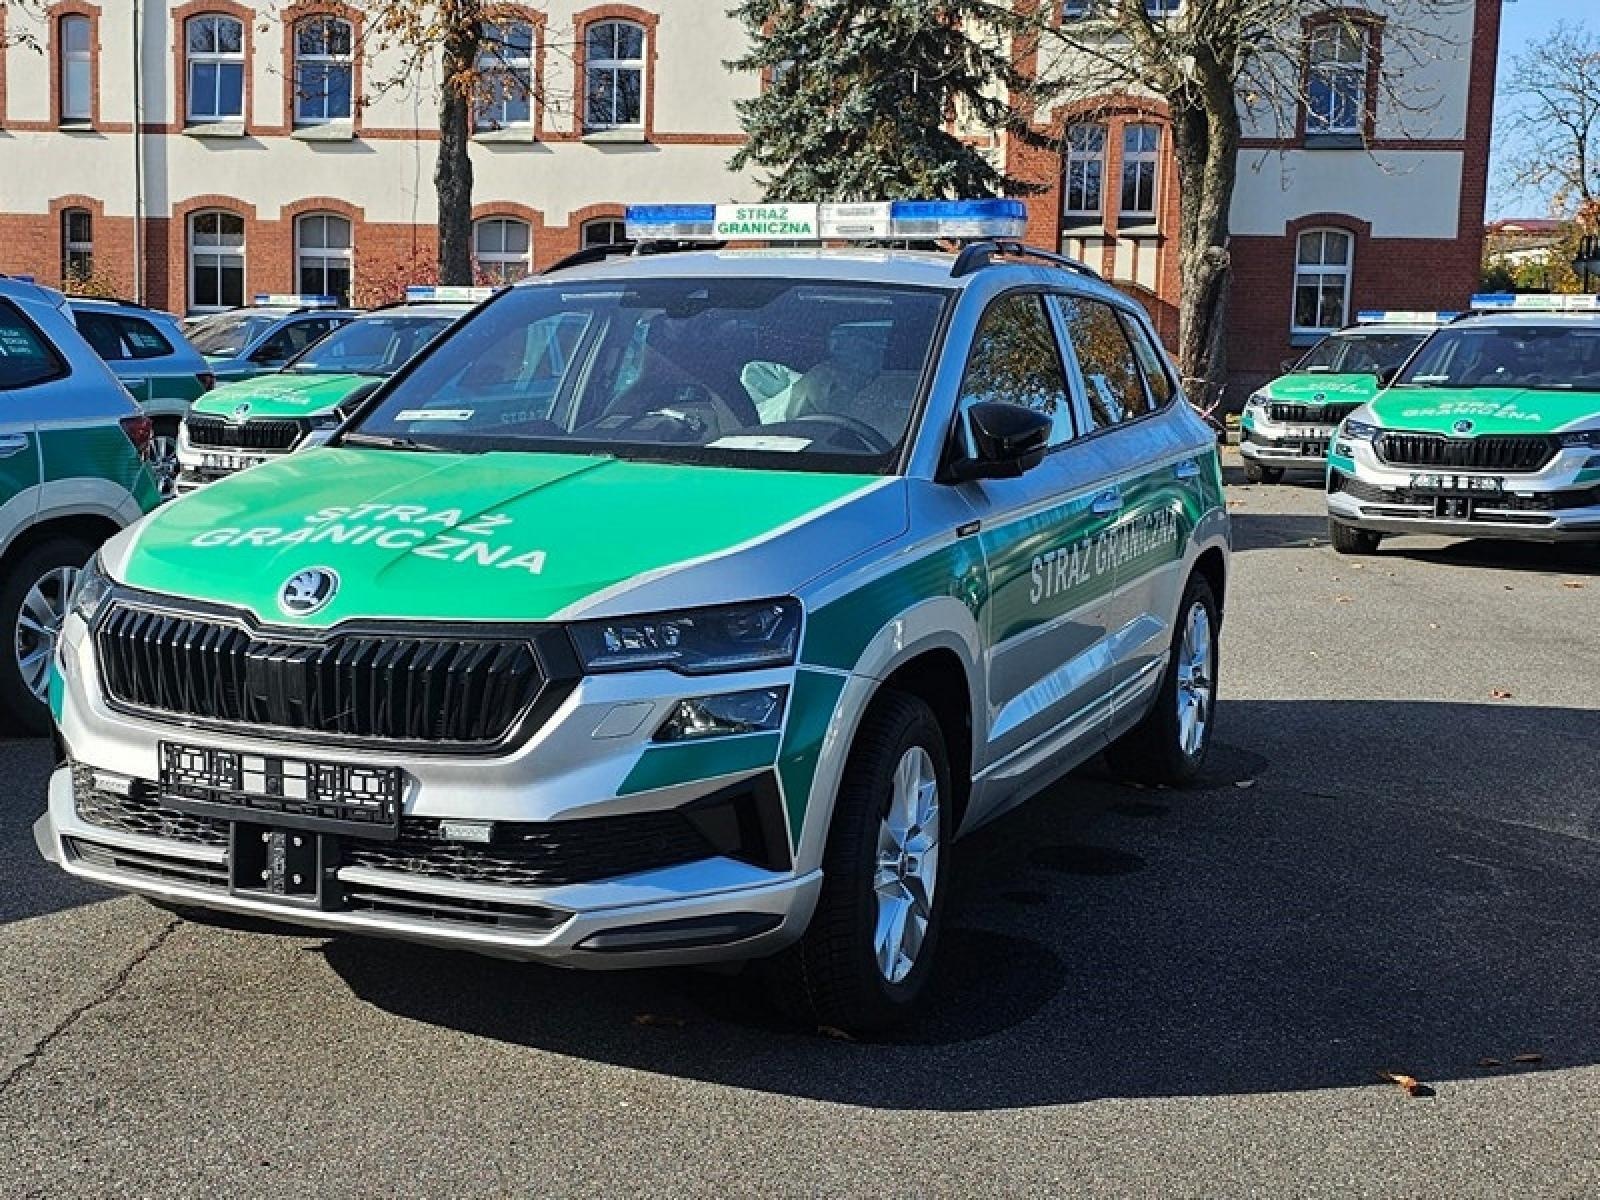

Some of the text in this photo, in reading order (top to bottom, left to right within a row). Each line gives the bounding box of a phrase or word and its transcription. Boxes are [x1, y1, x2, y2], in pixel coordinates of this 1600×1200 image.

[717, 222, 811, 235] GRANICZNA
[736, 206, 789, 220] STRAŻ
[304, 503, 513, 535] STRAŻ
[191, 525, 547, 575] GRANICZNA
[1030, 529, 1091, 604] STRAŻ
